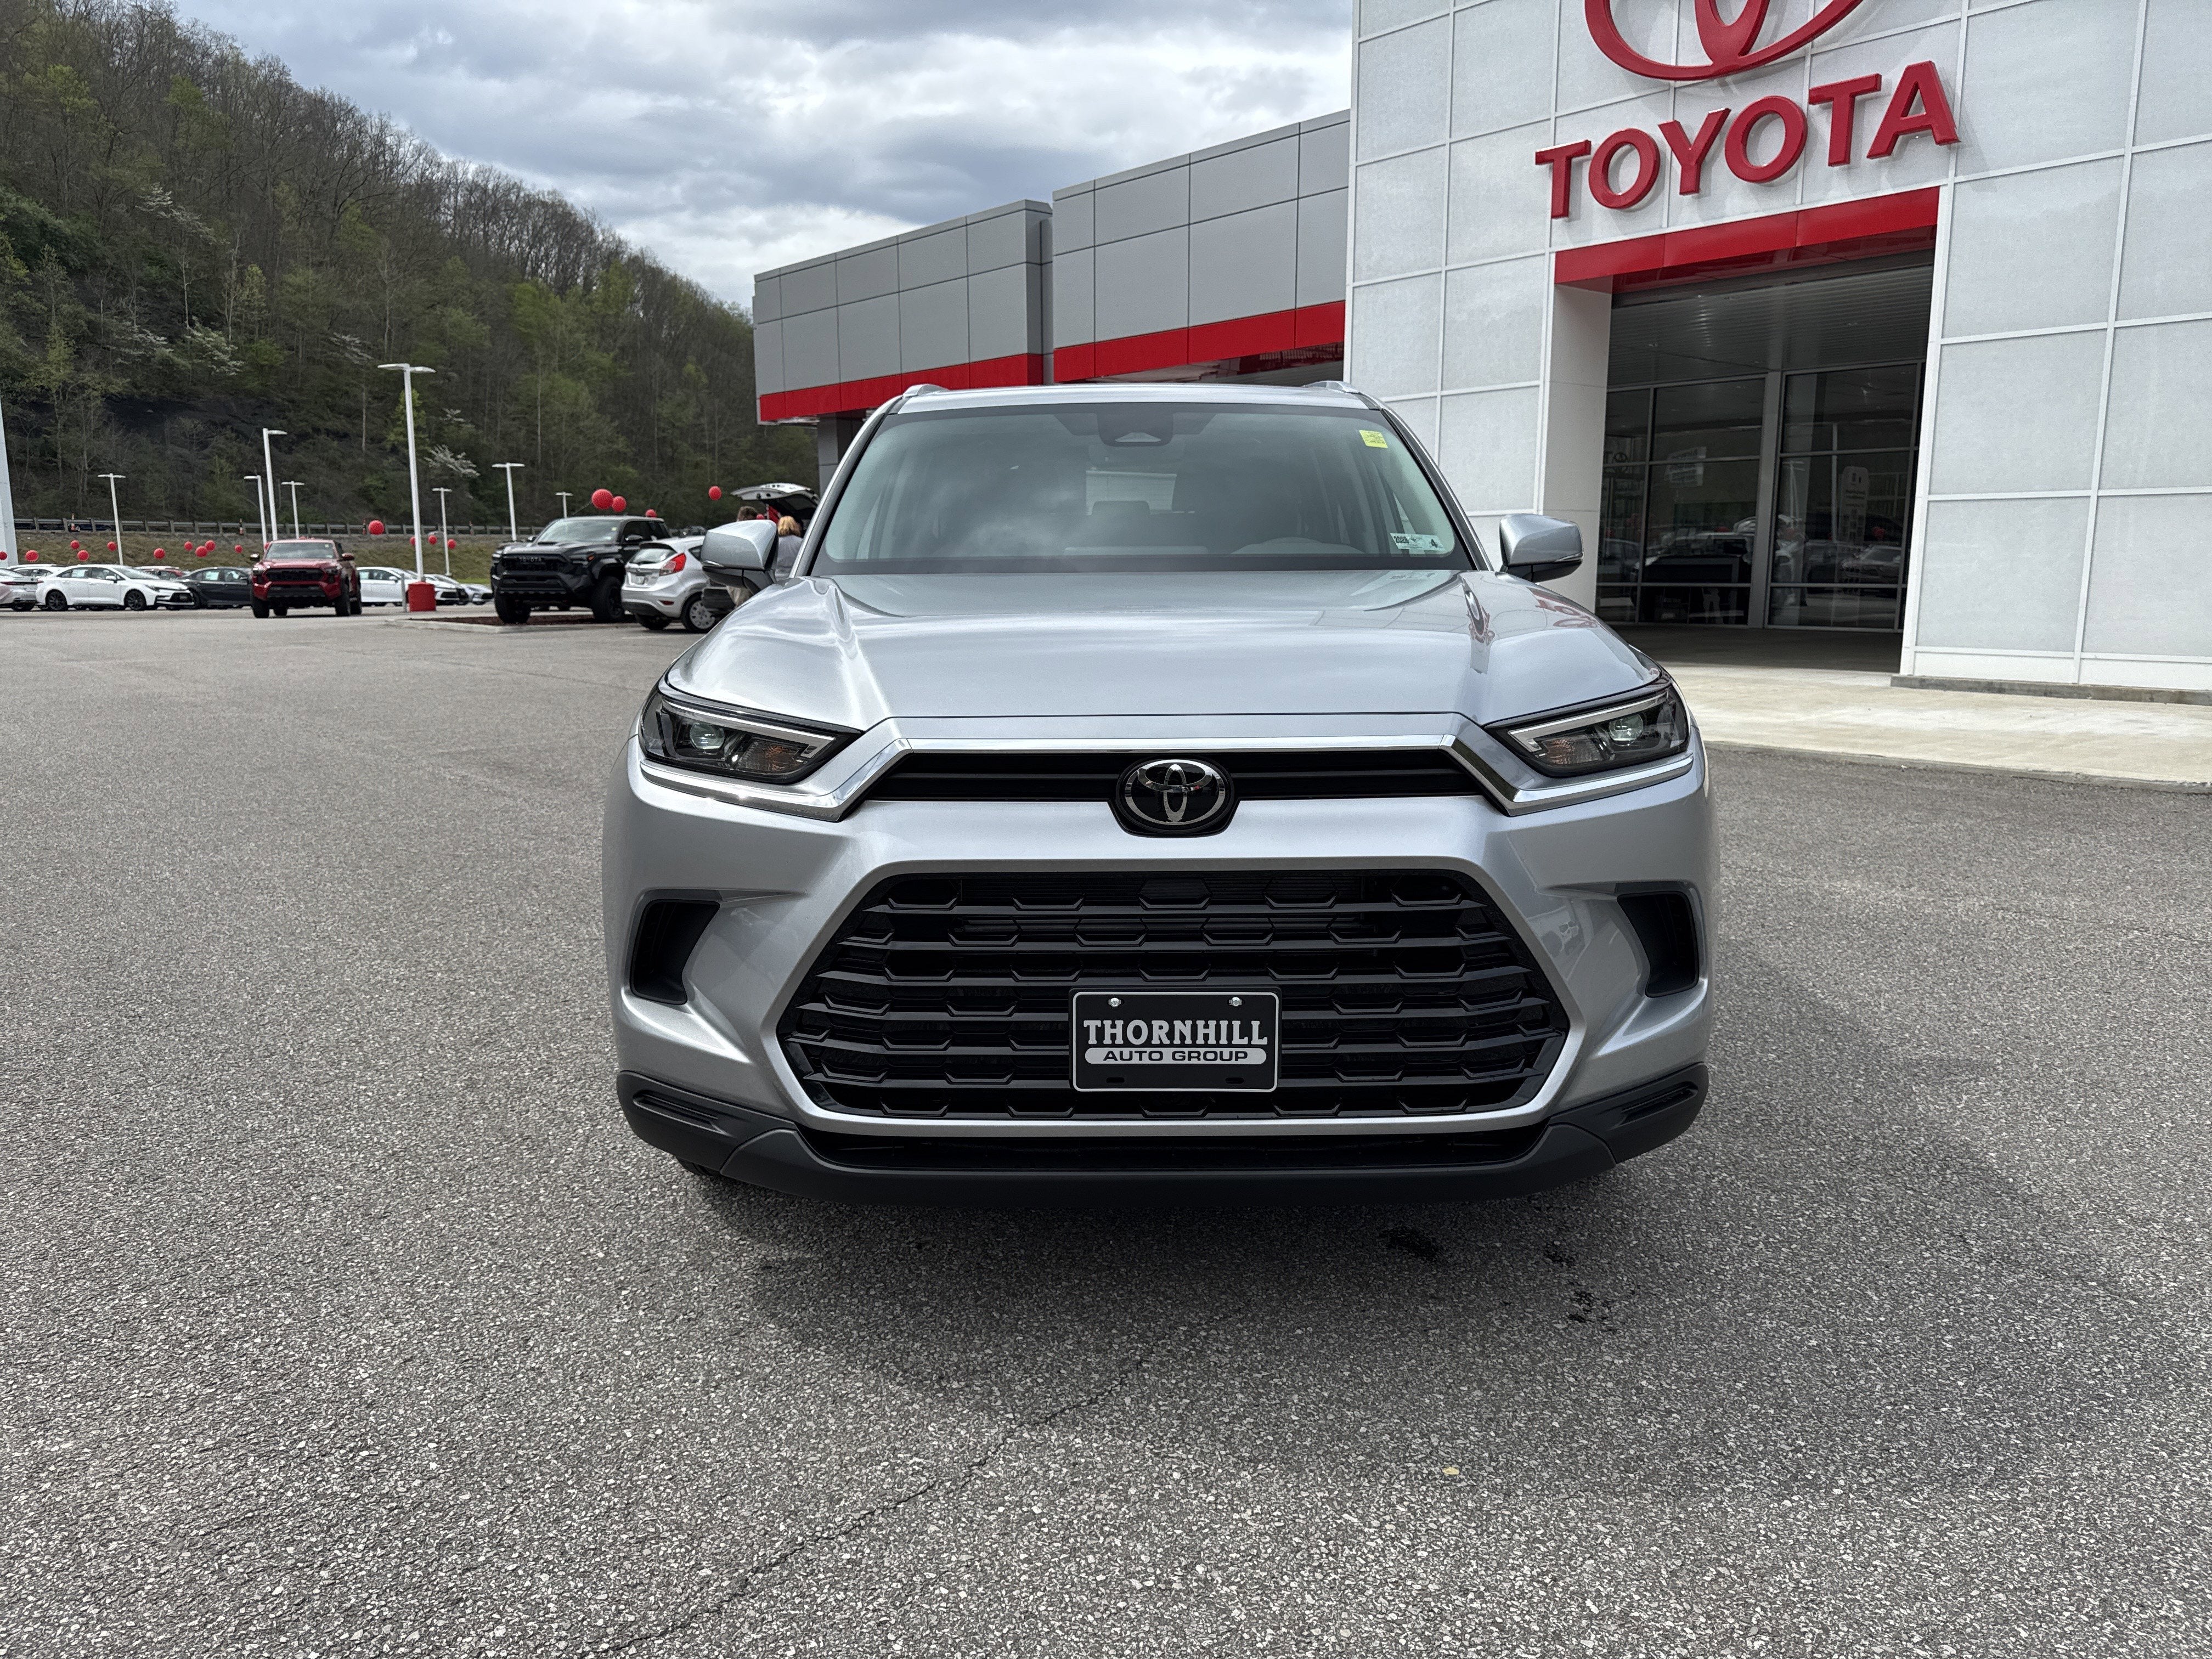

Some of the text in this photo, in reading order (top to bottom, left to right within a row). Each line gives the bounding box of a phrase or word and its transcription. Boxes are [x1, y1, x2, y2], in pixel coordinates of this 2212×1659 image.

[1535, 60, 1961, 219] TOYOTA
[1084, 1019, 1268, 1045] THORNHILL
[1103, 1050, 1248, 1062] AUTO GROUP
